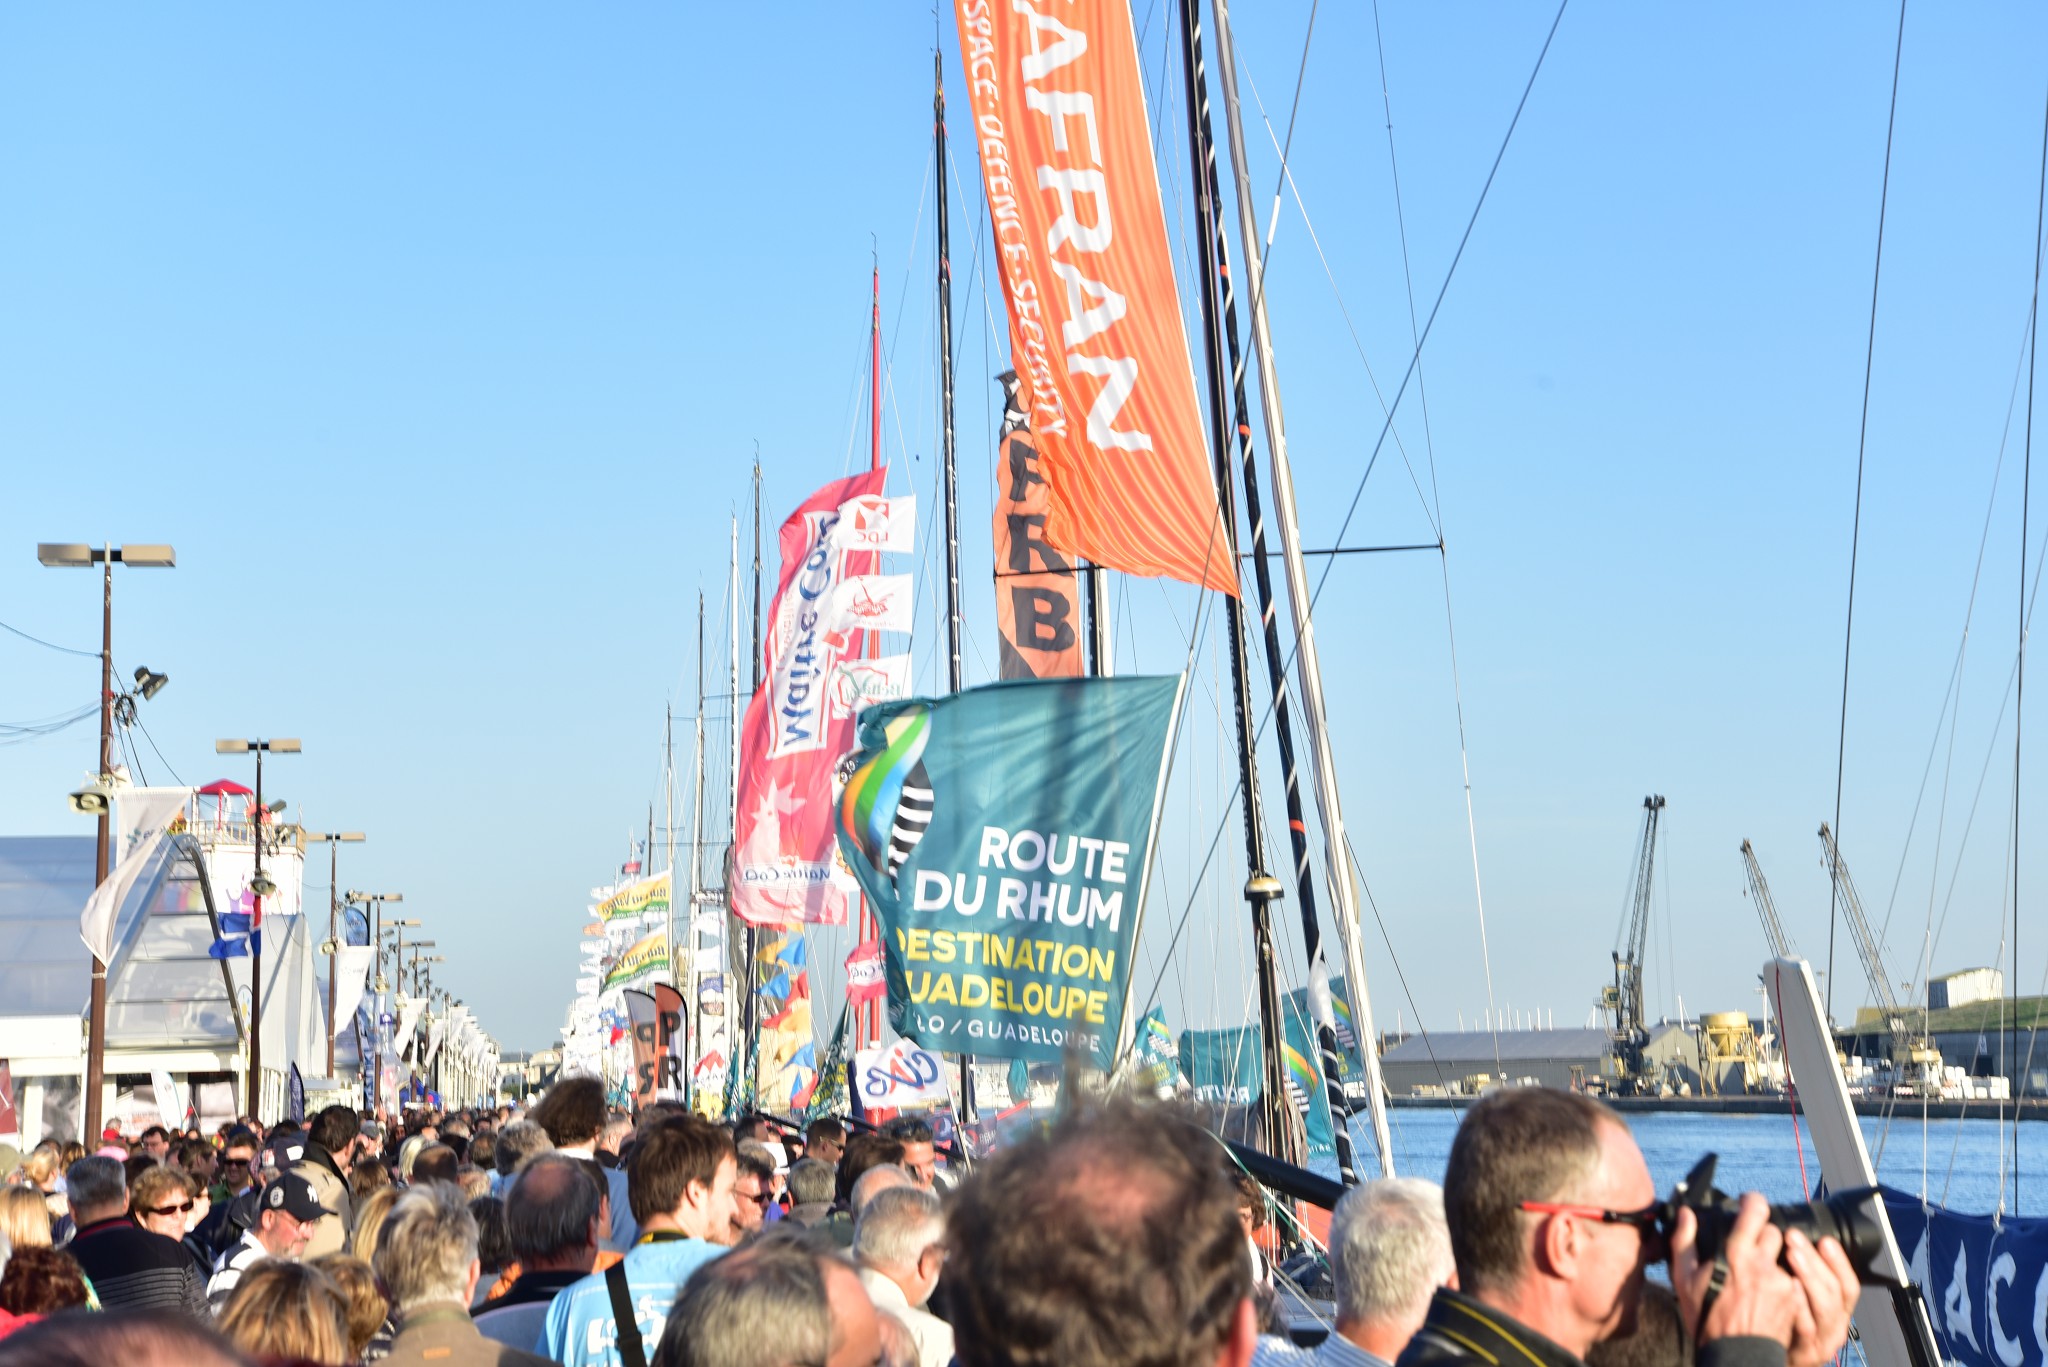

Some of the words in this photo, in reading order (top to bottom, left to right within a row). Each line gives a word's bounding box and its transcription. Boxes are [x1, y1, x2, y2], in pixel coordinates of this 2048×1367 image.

[1013, 0, 1154, 453] AFRAN
[979, 114, 1030, 262] DEFENCE
[1009, 276, 1067, 438] SECURITY
[978, 825, 1131, 885] ROUTE
[913, 869, 987, 916] DU
[996, 878, 1124, 932] RHUM
[905, 970, 1108, 1024] UADELOUPE
[913, 1010, 945, 1034] LO
[967, 1019, 1101, 1053] GUADELOUPE
